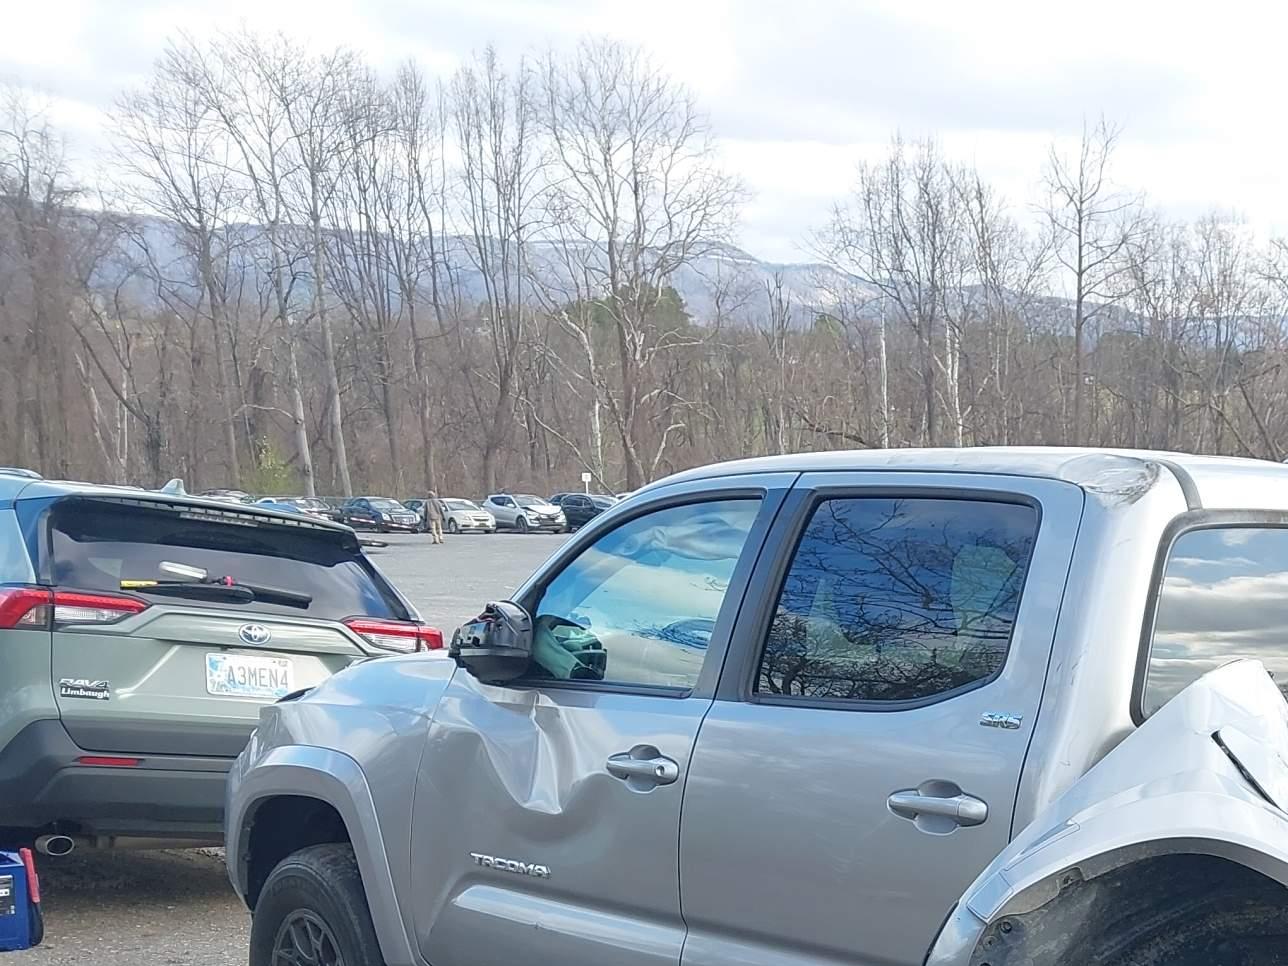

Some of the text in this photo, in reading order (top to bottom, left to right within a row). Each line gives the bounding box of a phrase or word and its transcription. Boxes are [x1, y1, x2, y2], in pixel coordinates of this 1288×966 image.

[60, 678, 110, 689] RAV4
[227, 665, 289, 689] A3MEN4
[61, 687, 110, 699] Limbaugh
[469, 852, 552, 879] TACOMA
